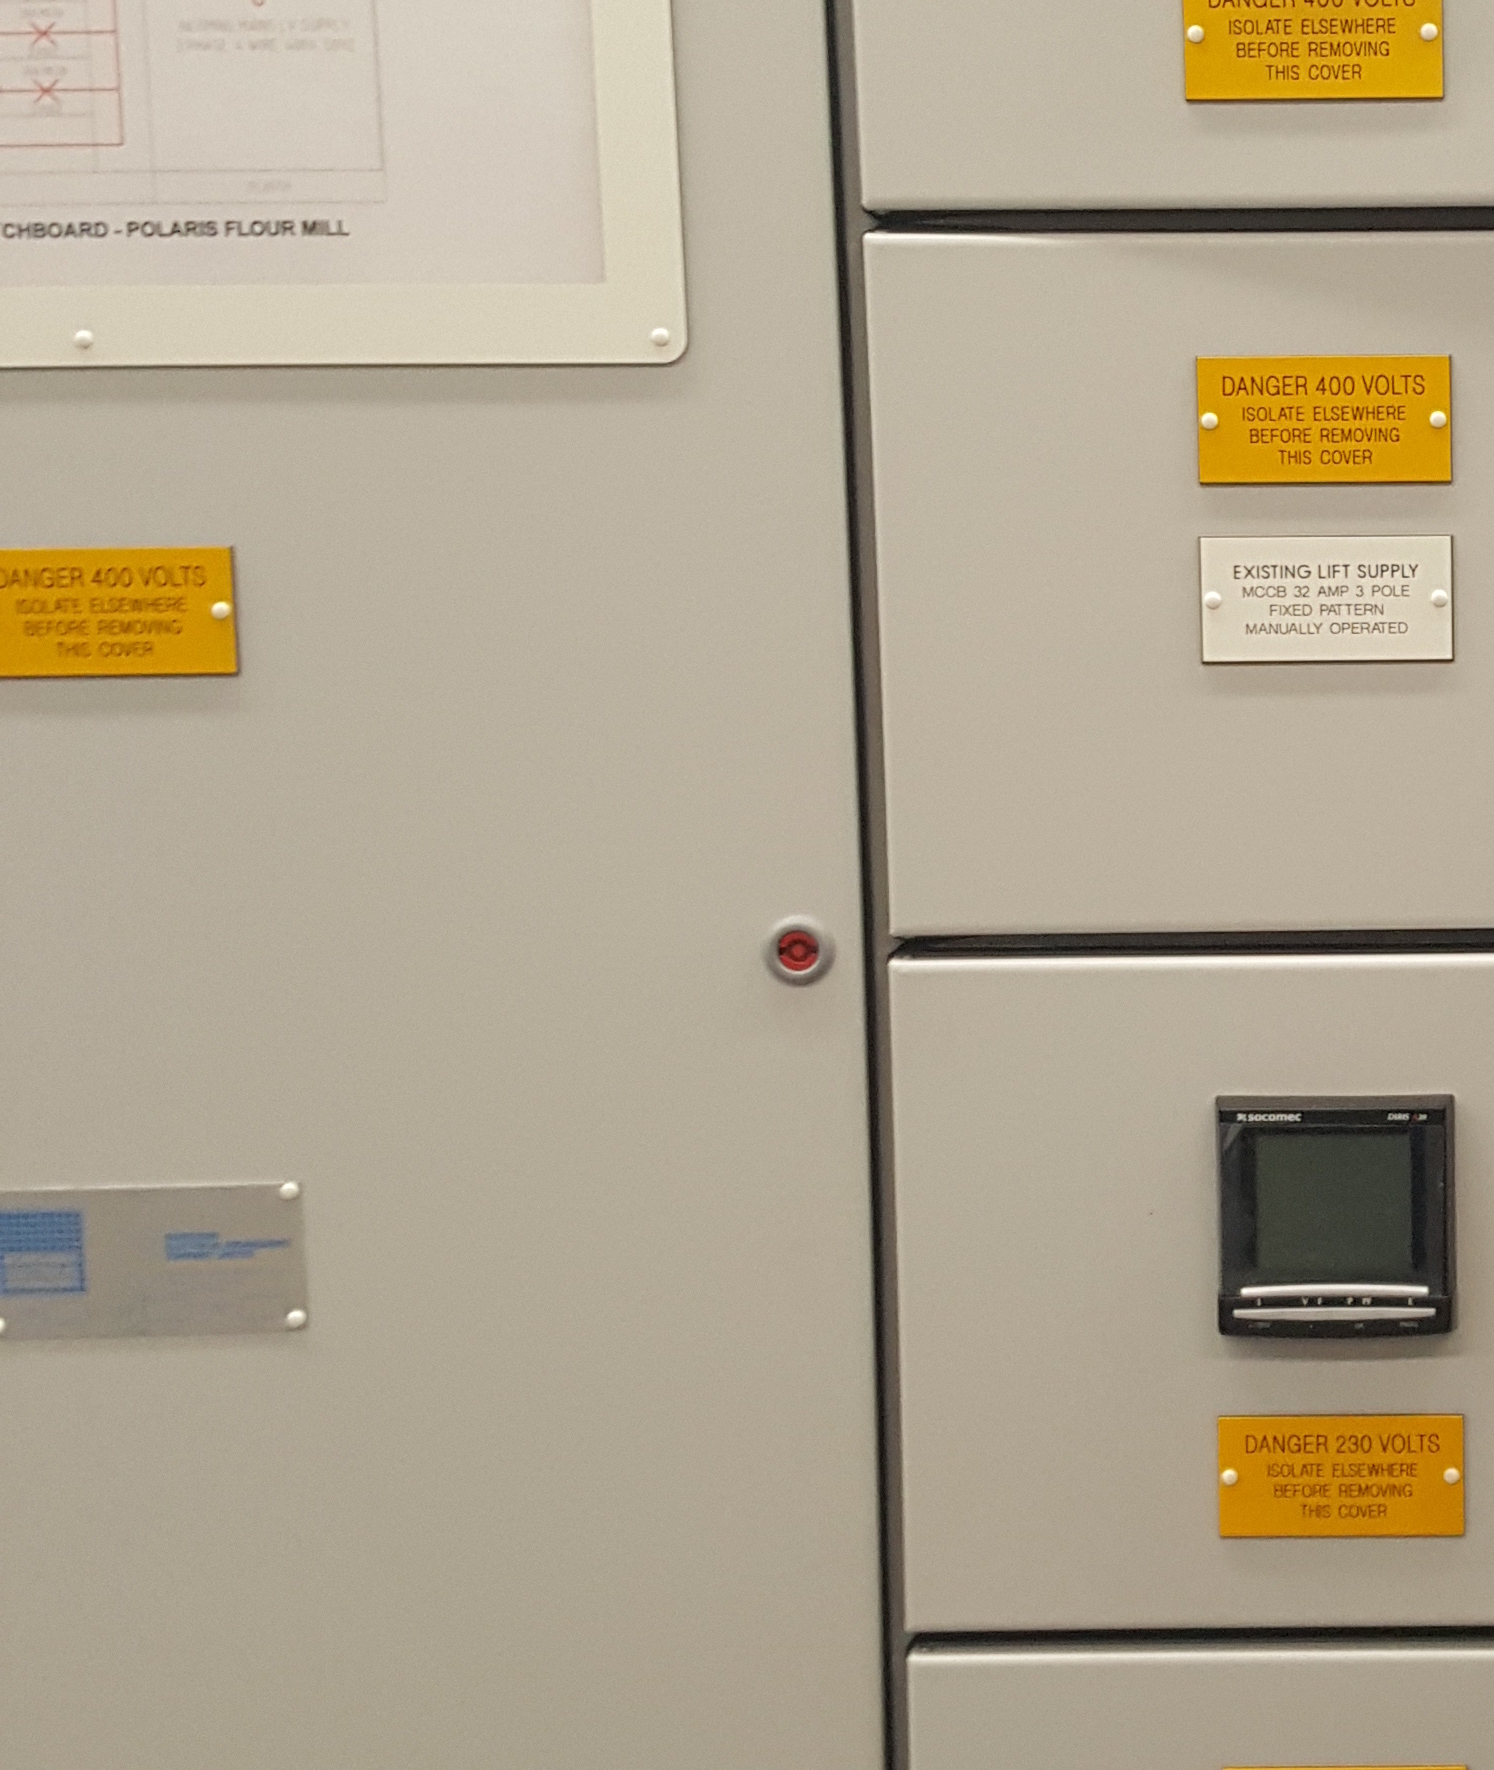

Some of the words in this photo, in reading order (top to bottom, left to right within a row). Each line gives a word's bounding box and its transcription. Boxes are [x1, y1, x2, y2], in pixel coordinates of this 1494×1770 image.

[1229, 19, 1292, 35] ISOLATE
[1301, 18, 1396, 34] ELSEWHERE
[1236, 42, 1300, 58] BEFORE
[1308, 41, 1390, 57] REMOVING
[1266, 65, 1300, 80] THIS
[1309, 64, 1362, 79] COVER
[0, 222, 108, 239] CHBOARD
[127, 221, 218, 237] POLARIS
[225, 220, 295, 236] FLOUR
[301, 221, 349, 236] MILL
[1222, 376, 1307, 396] DANGER
[1316, 376, 1354, 396] 400
[1362, 375, 1425, 395] VOLTS
[1242, 406, 1304, 422] ISOLATE
[1313, 405, 1406, 421] ELSEWHERE
[1250, 429, 1312, 444] BEFORE
[1320, 428, 1400, 443] REMOVING
[1278, 450, 1312, 465] THIS
[1320, 449, 1373, 465] COVER
[0, 567, 84, 589] DANGER
[92, 567, 133, 587] 400
[140, 565, 206, 587] VOLTS
[1234, 565, 1311, 580] EXISTING
[1318, 565, 1350, 579] LIFT
[1357, 564, 1419, 579] SUPPLY
[1242, 586, 1286, 598] MCCB
[1293, 586, 1310, 597] 32
[1317, 586, 1349, 597] AMP
[1356, 585, 1364, 597] 3
[1371, 585, 1410, 597] POLE
[16, 598, 82, 614] ISOLATE
[89, 597, 188, 613] ELSEWHERE
[1269, 605, 1312, 616] FIXED
[1320, 604, 1384, 616] PATTERN
[24, 620, 90, 636] BEFORE
[98, 619, 182, 635] REMOVING
[1245, 623, 1322, 635] MANUALLY
[1329, 622, 1408, 634] OPERATED
[57, 642, 92, 658] THIS
[99, 641, 154, 657] COVER
[1248, 1113, 1302, 1121] socomec
[1245, 1434, 1328, 1454] DANGER
[1336, 1434, 1372, 1454] 230
[1379, 1434, 1440, 1454] VOLTS
[1268, 1463, 1324, 1478] ISOLATE
[1332, 1463, 1417, 1478] ELSEWHERE
[1274, 1484, 1331, 1498] BEFORE
[1338, 1483, 1413, 1497] REMOVING
[1301, 1505, 1331, 1519] THIS
[1339, 1504, 1387, 1518] COVER
